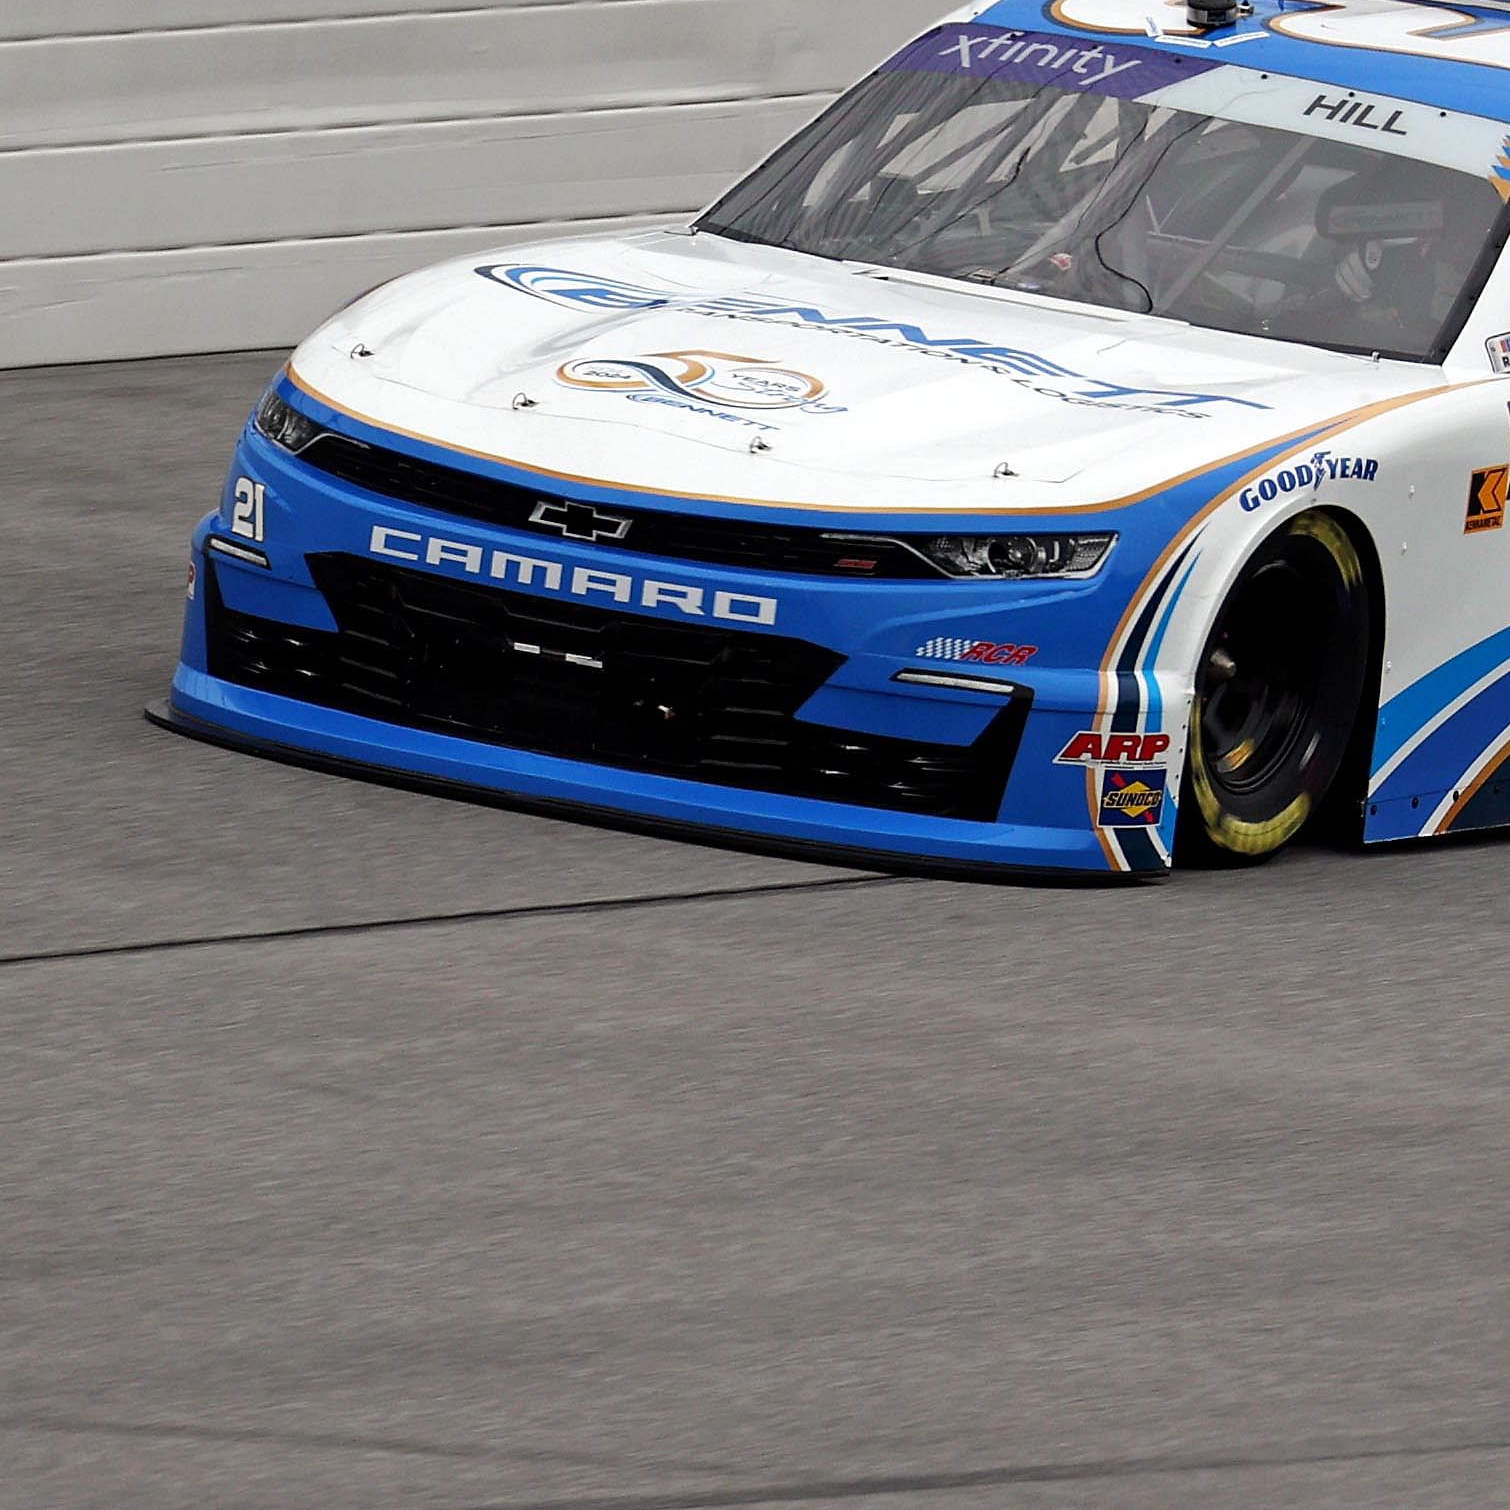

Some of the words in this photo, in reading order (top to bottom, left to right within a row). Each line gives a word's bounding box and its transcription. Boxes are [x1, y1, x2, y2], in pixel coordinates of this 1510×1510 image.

[939, 35, 1142, 87] xfinity
[1303, 94, 1408, 136] HILL
[731, 372, 801, 392] YEARS
[1010, 376, 1212, 419] LOGISTICS
[640, 395, 781, 430] BENNETT
[1238, 453, 1379, 512] GOODYEAR
[231, 476, 266, 542] 21
[369, 524, 778, 626] CAMARO
[960, 641, 1039, 667] RCR
[1059, 732, 1171, 761] ARP
[1103, 791, 1162, 808] SUNOCO
